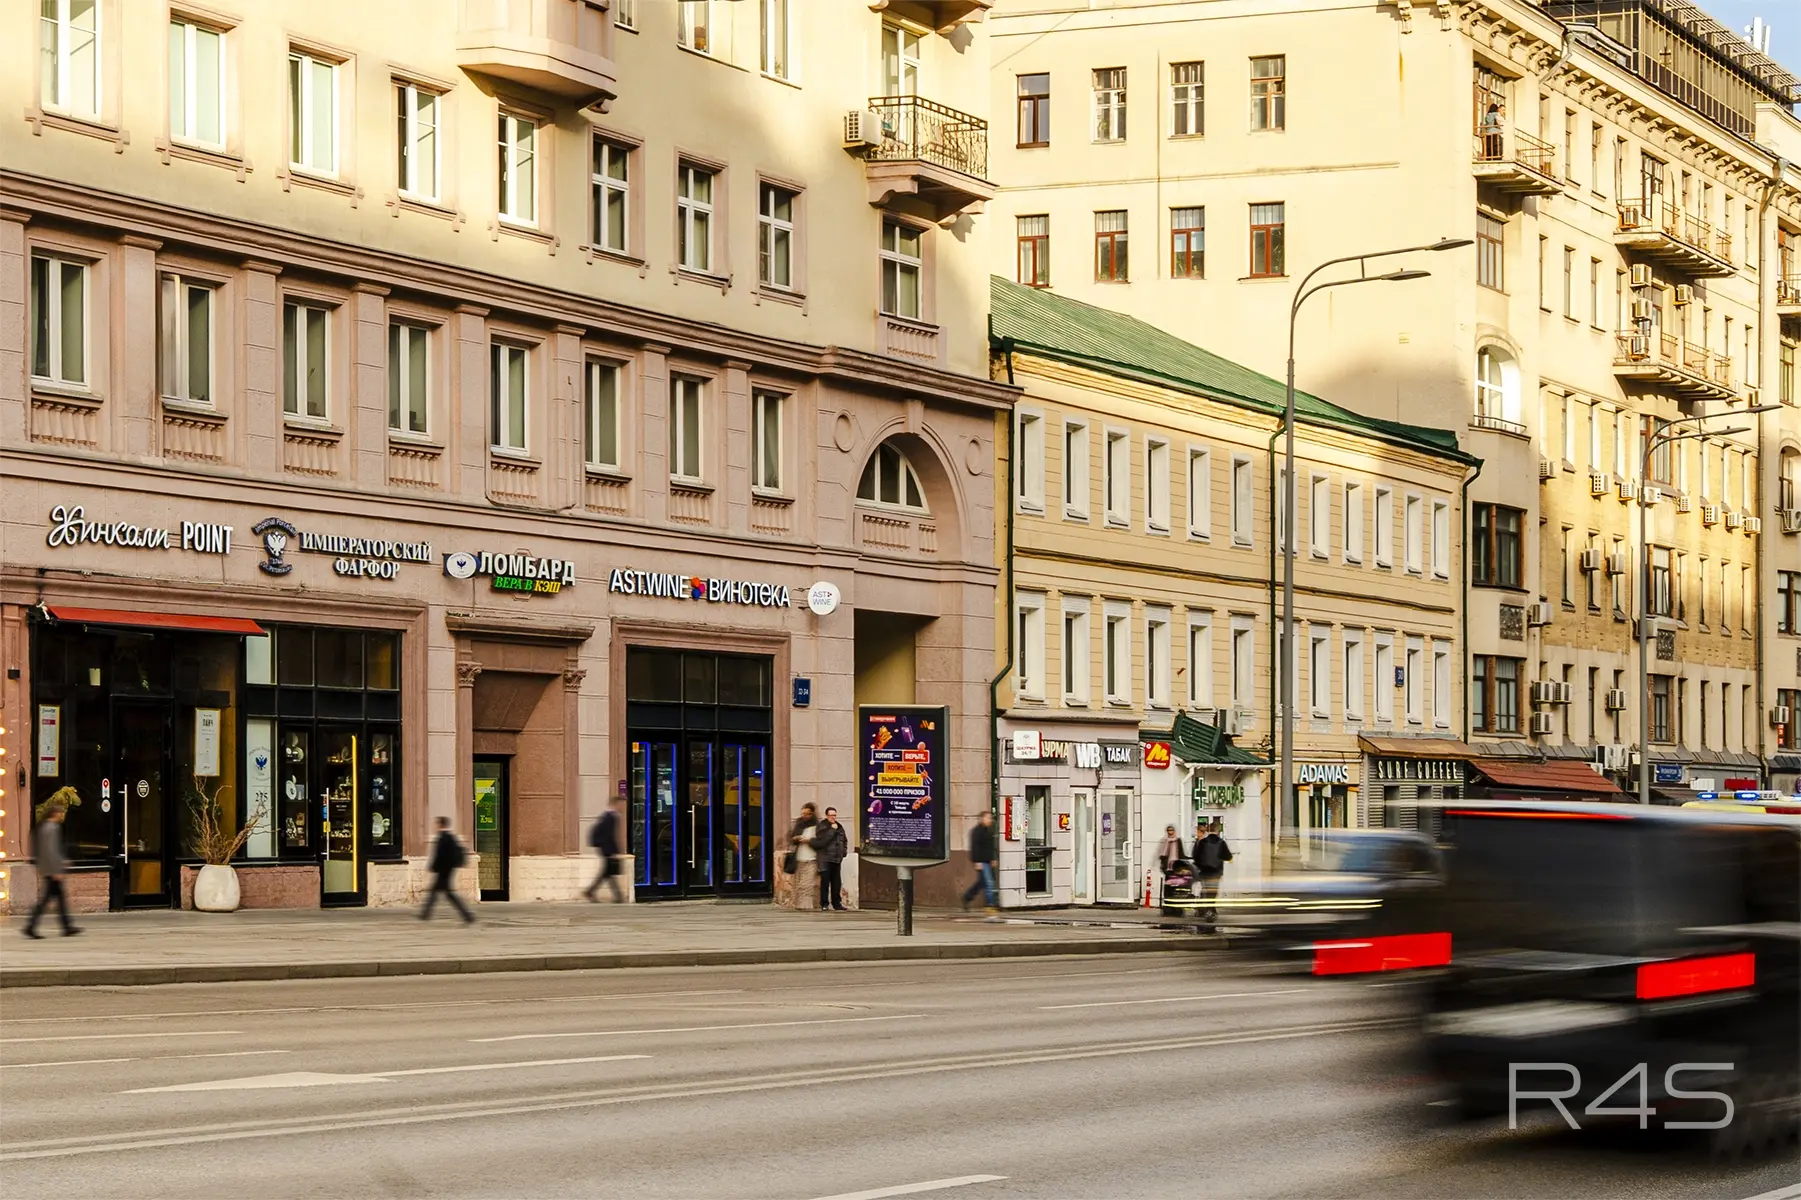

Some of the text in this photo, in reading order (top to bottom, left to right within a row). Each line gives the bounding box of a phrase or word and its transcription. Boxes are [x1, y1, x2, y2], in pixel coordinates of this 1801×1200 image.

[181, 521, 234, 554] POINT
[301, 531, 432, 562] ИМПЕРАТОРСКИЙ
[334, 557, 401, 579] ФАРФОР
[479, 551, 576, 586] ЛОМБАРД
[495, 576, 561, 593] ВЕРА В КЭШ
[812, 590, 827, 599] AST
[812, 598, 832, 606] WINE
[1076, 743, 1101, 768] WB
[1106, 746, 1131, 762] ТАБАК
[1300, 764, 1348, 783] ADAMAS
[1378, 760, 1458, 779] SURF COFFEE
